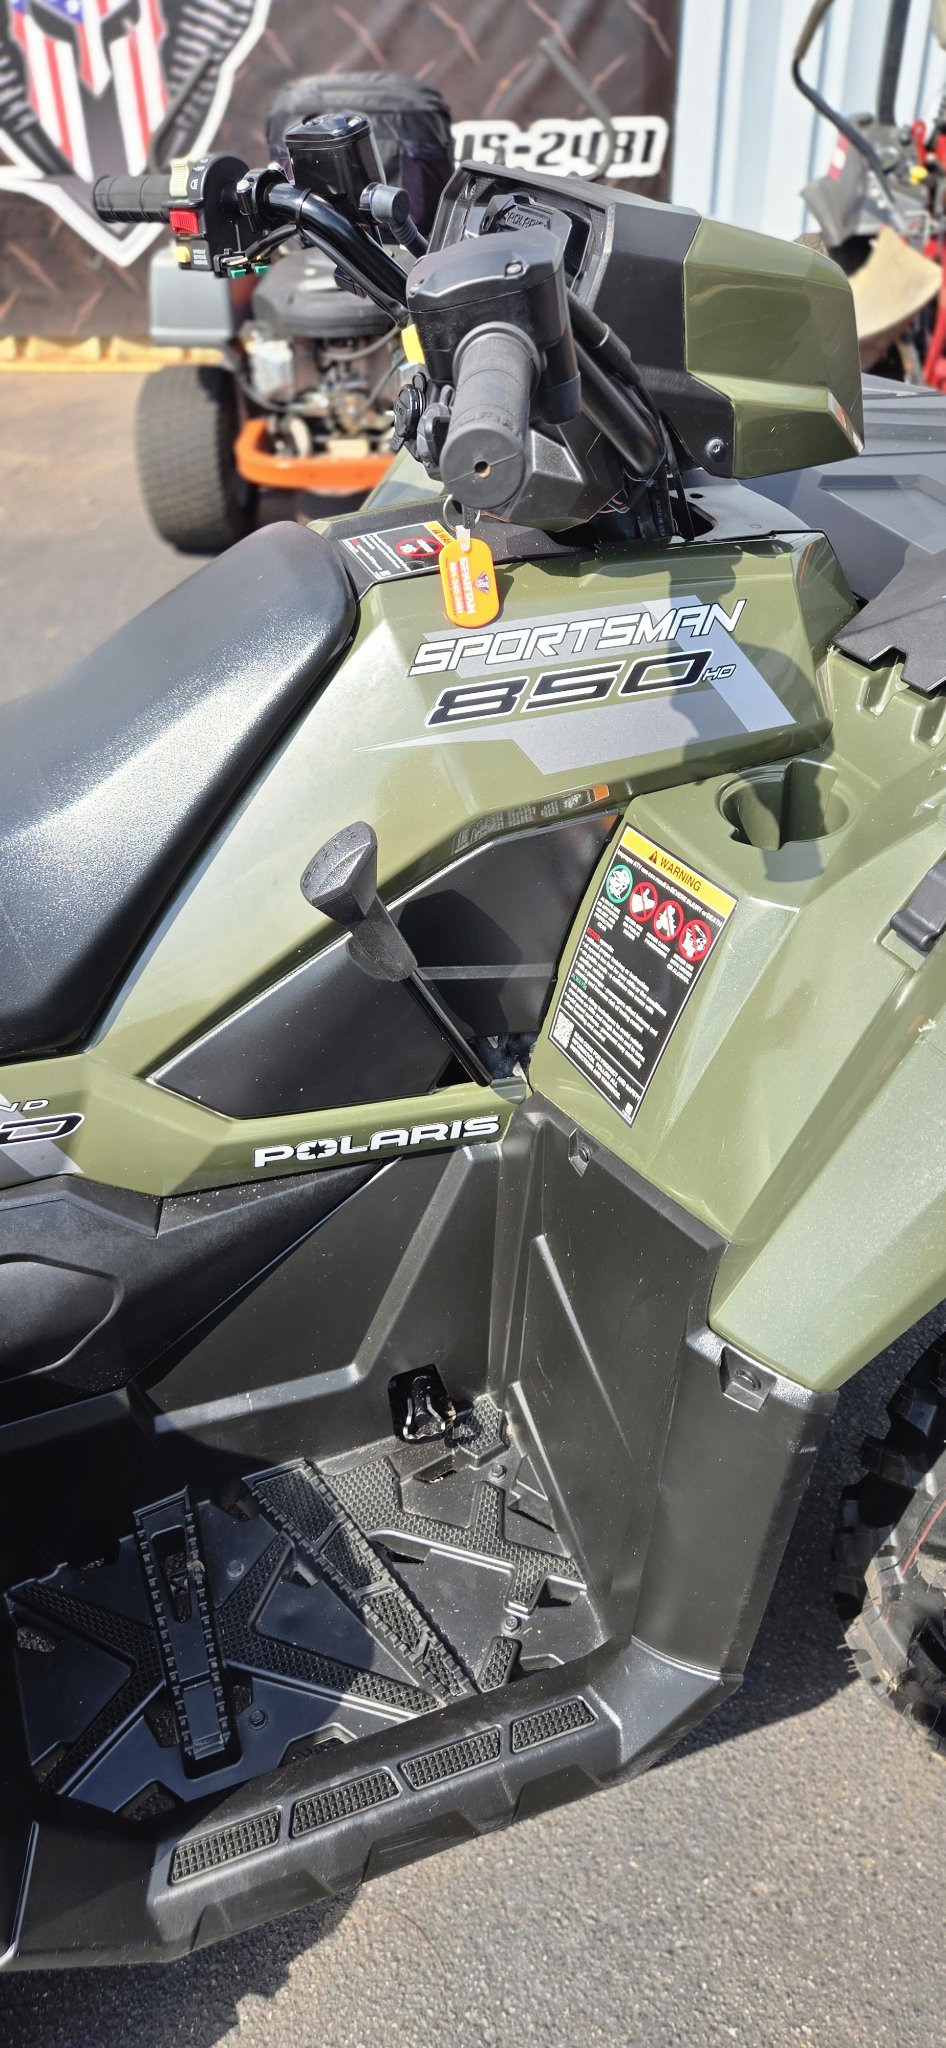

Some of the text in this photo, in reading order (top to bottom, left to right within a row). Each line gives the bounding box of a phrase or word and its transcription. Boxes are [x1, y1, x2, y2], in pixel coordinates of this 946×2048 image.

[459, 556, 476, 614] SPARTAN
[408, 599, 747, 677] SPORTSMAN
[425, 649, 737, 727] 850 HD
[660, 856, 702, 892] WARNING
[253, 1115, 500, 1169] POLARIS
